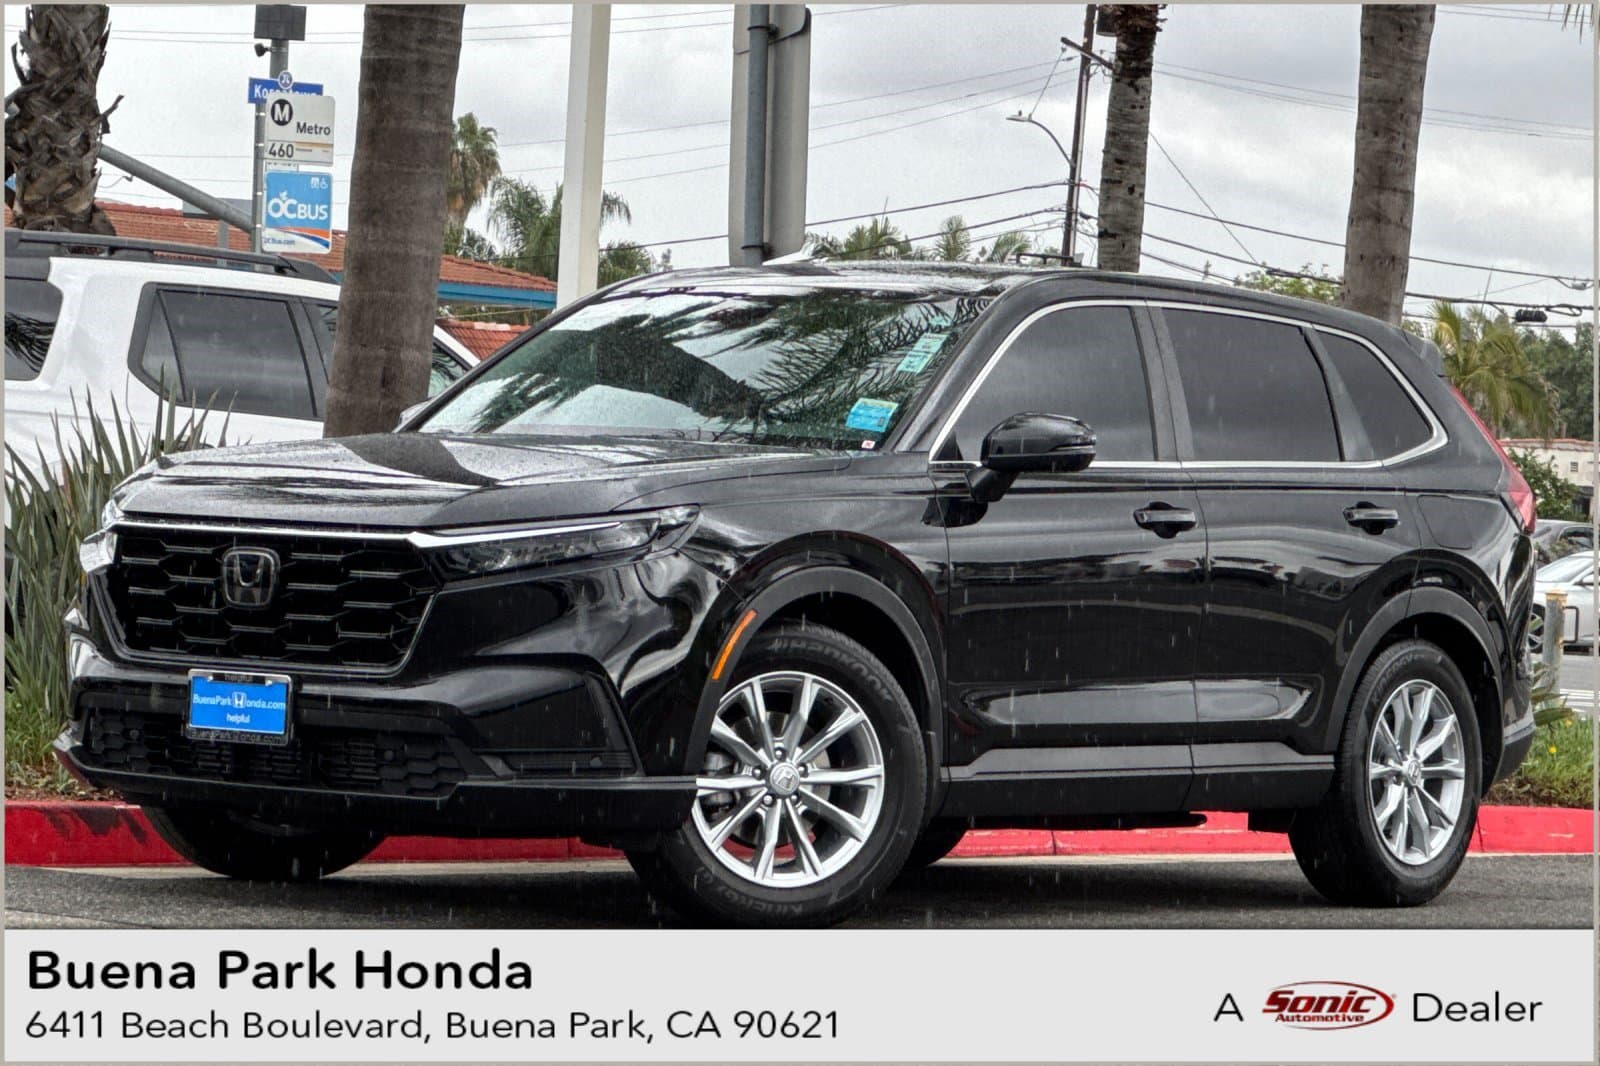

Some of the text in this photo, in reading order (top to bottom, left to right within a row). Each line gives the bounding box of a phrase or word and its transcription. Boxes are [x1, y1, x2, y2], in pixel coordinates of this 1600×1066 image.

[273, 103, 291, 122] M
[296, 121, 331, 136] Metro
[268, 143, 294, 158] 460
[226, 713, 251, 724] helpful
